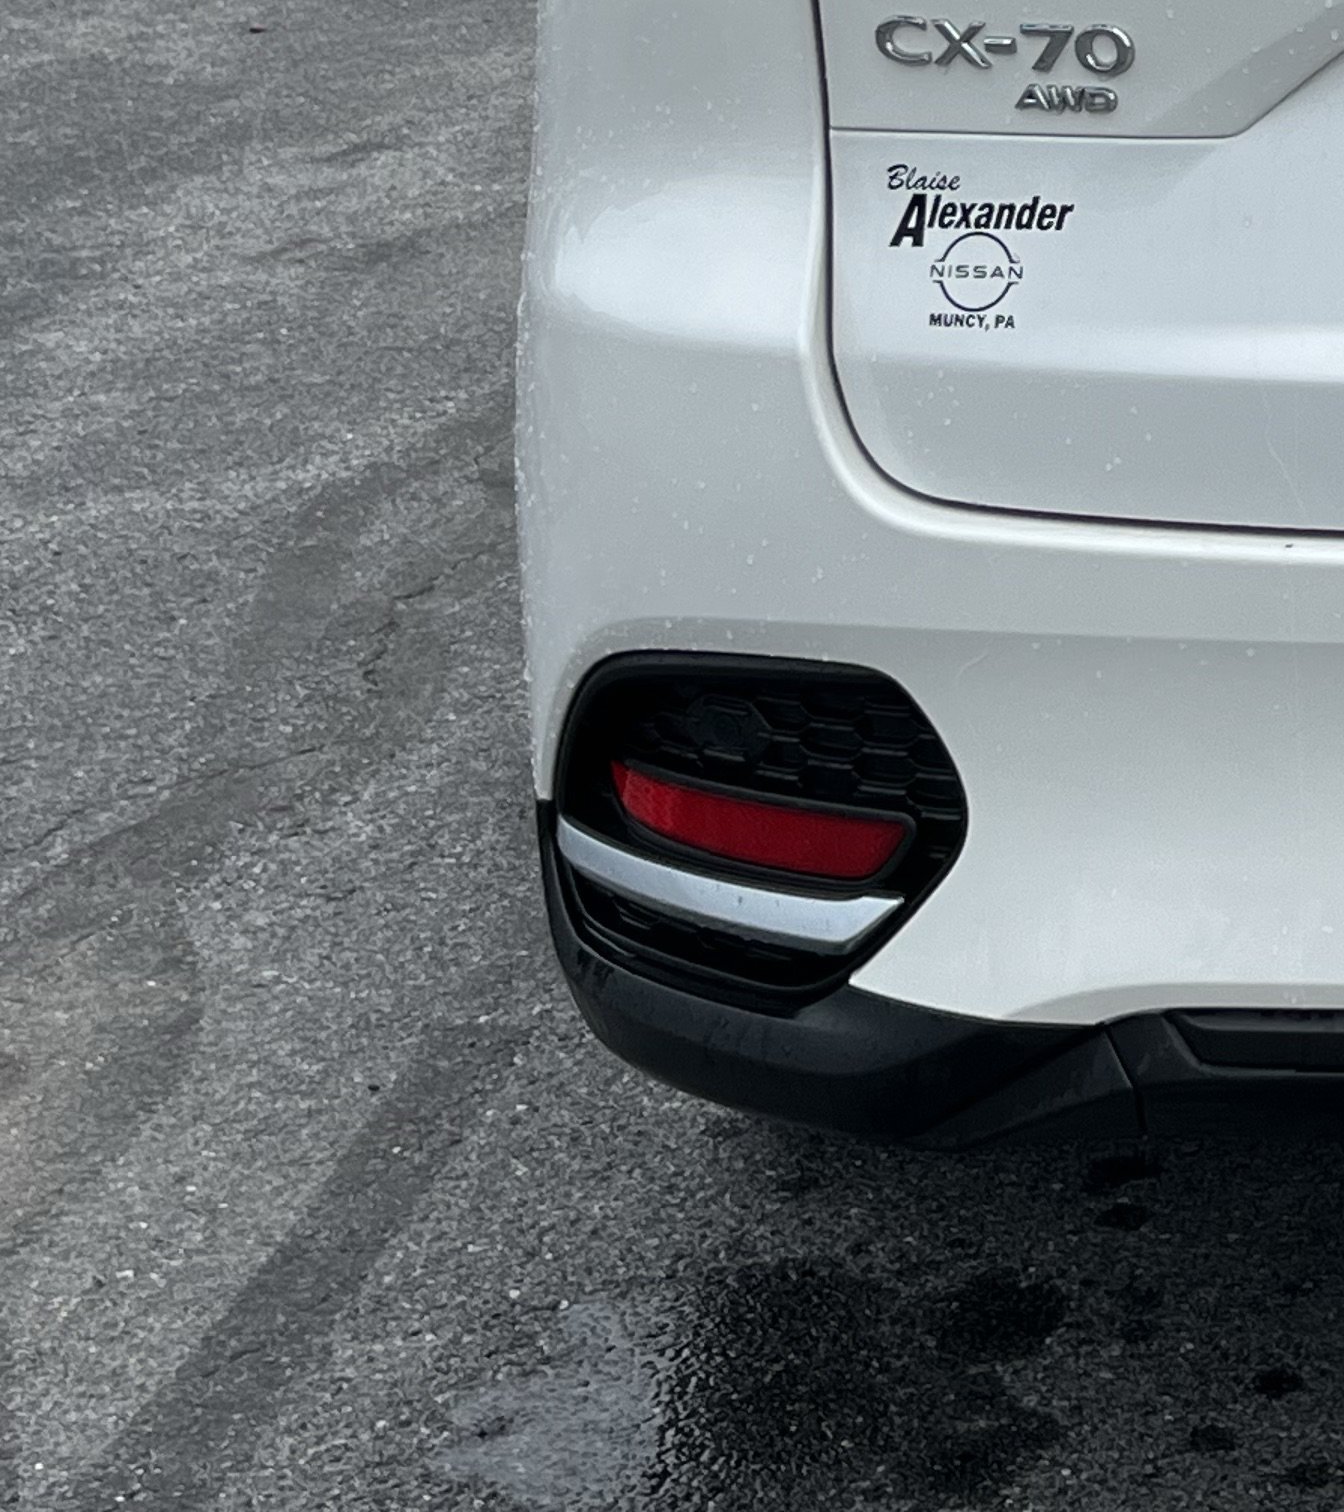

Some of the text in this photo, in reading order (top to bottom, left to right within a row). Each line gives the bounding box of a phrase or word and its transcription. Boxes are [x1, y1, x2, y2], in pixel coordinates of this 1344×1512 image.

[875, 15, 1135, 77] CX-70
[1014, 83, 1119, 114] AWD
[886, 164, 961, 191] Blaise
[889, 193, 1074, 247] Alexander
[930, 265, 1023, 279] NISSAN
[929, 314, 1016, 331] MUNCY, PA
